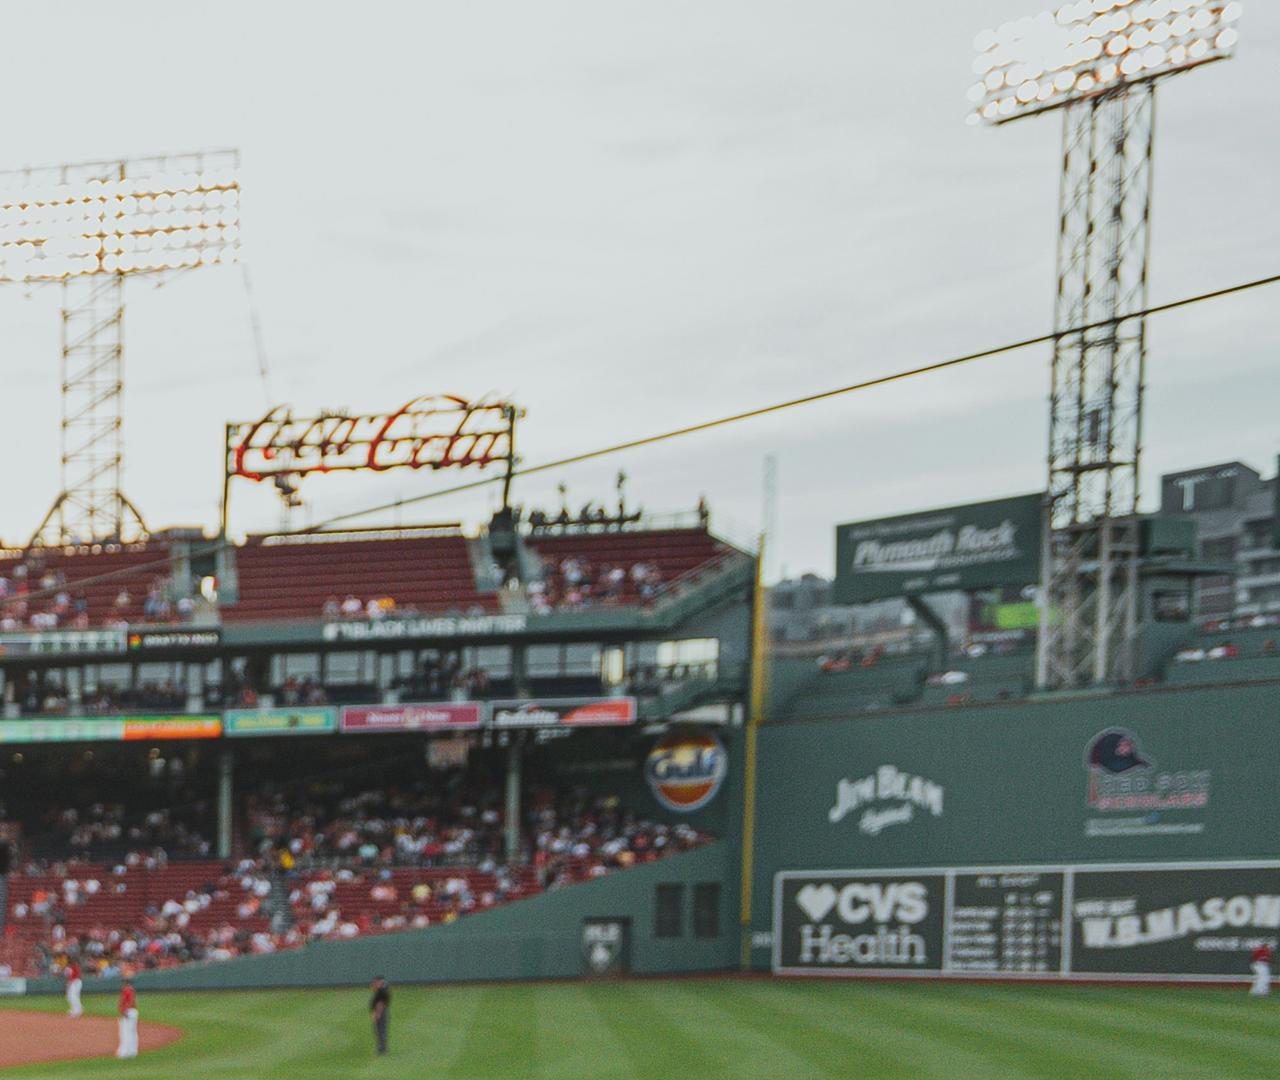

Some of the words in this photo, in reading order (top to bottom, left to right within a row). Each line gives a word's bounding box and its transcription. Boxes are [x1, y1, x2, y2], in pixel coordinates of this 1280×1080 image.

[852, 527, 955, 565] Plymouth
[956, 519, 1017, 551] Rock
[653, 747, 720, 780] Gulf
[828, 775, 875, 823] JIM
[877, 764, 944, 817] BEAM
[838, 881, 929, 925] CVS
[799, 924, 927, 964] Health
